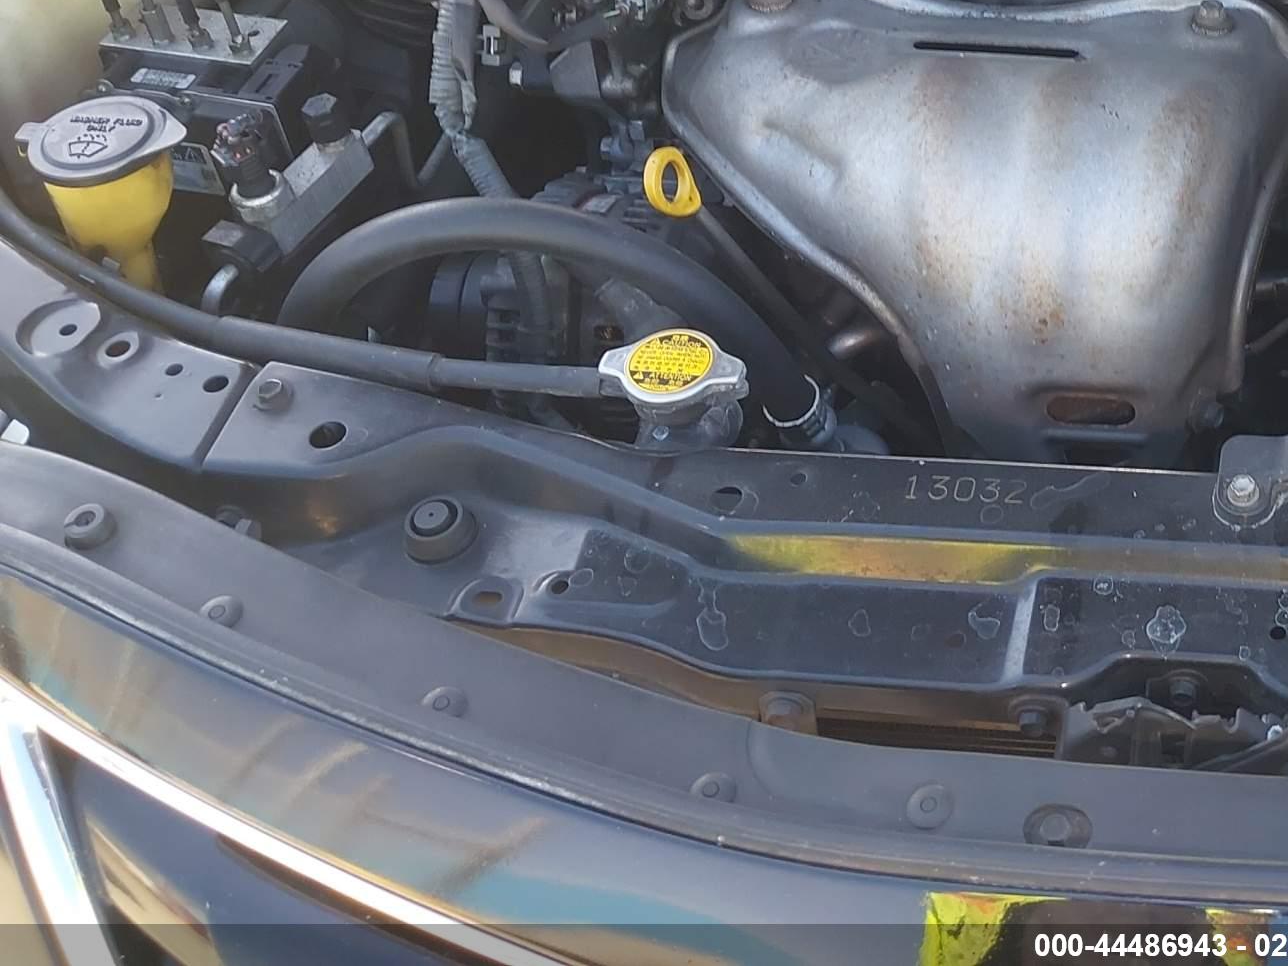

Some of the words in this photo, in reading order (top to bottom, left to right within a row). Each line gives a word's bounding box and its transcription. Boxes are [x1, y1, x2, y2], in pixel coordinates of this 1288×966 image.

[662, 338, 702, 348] CAUTION
[649, 371, 692, 381] ATTENTION
[904, 474, 1028, 505] 13032
